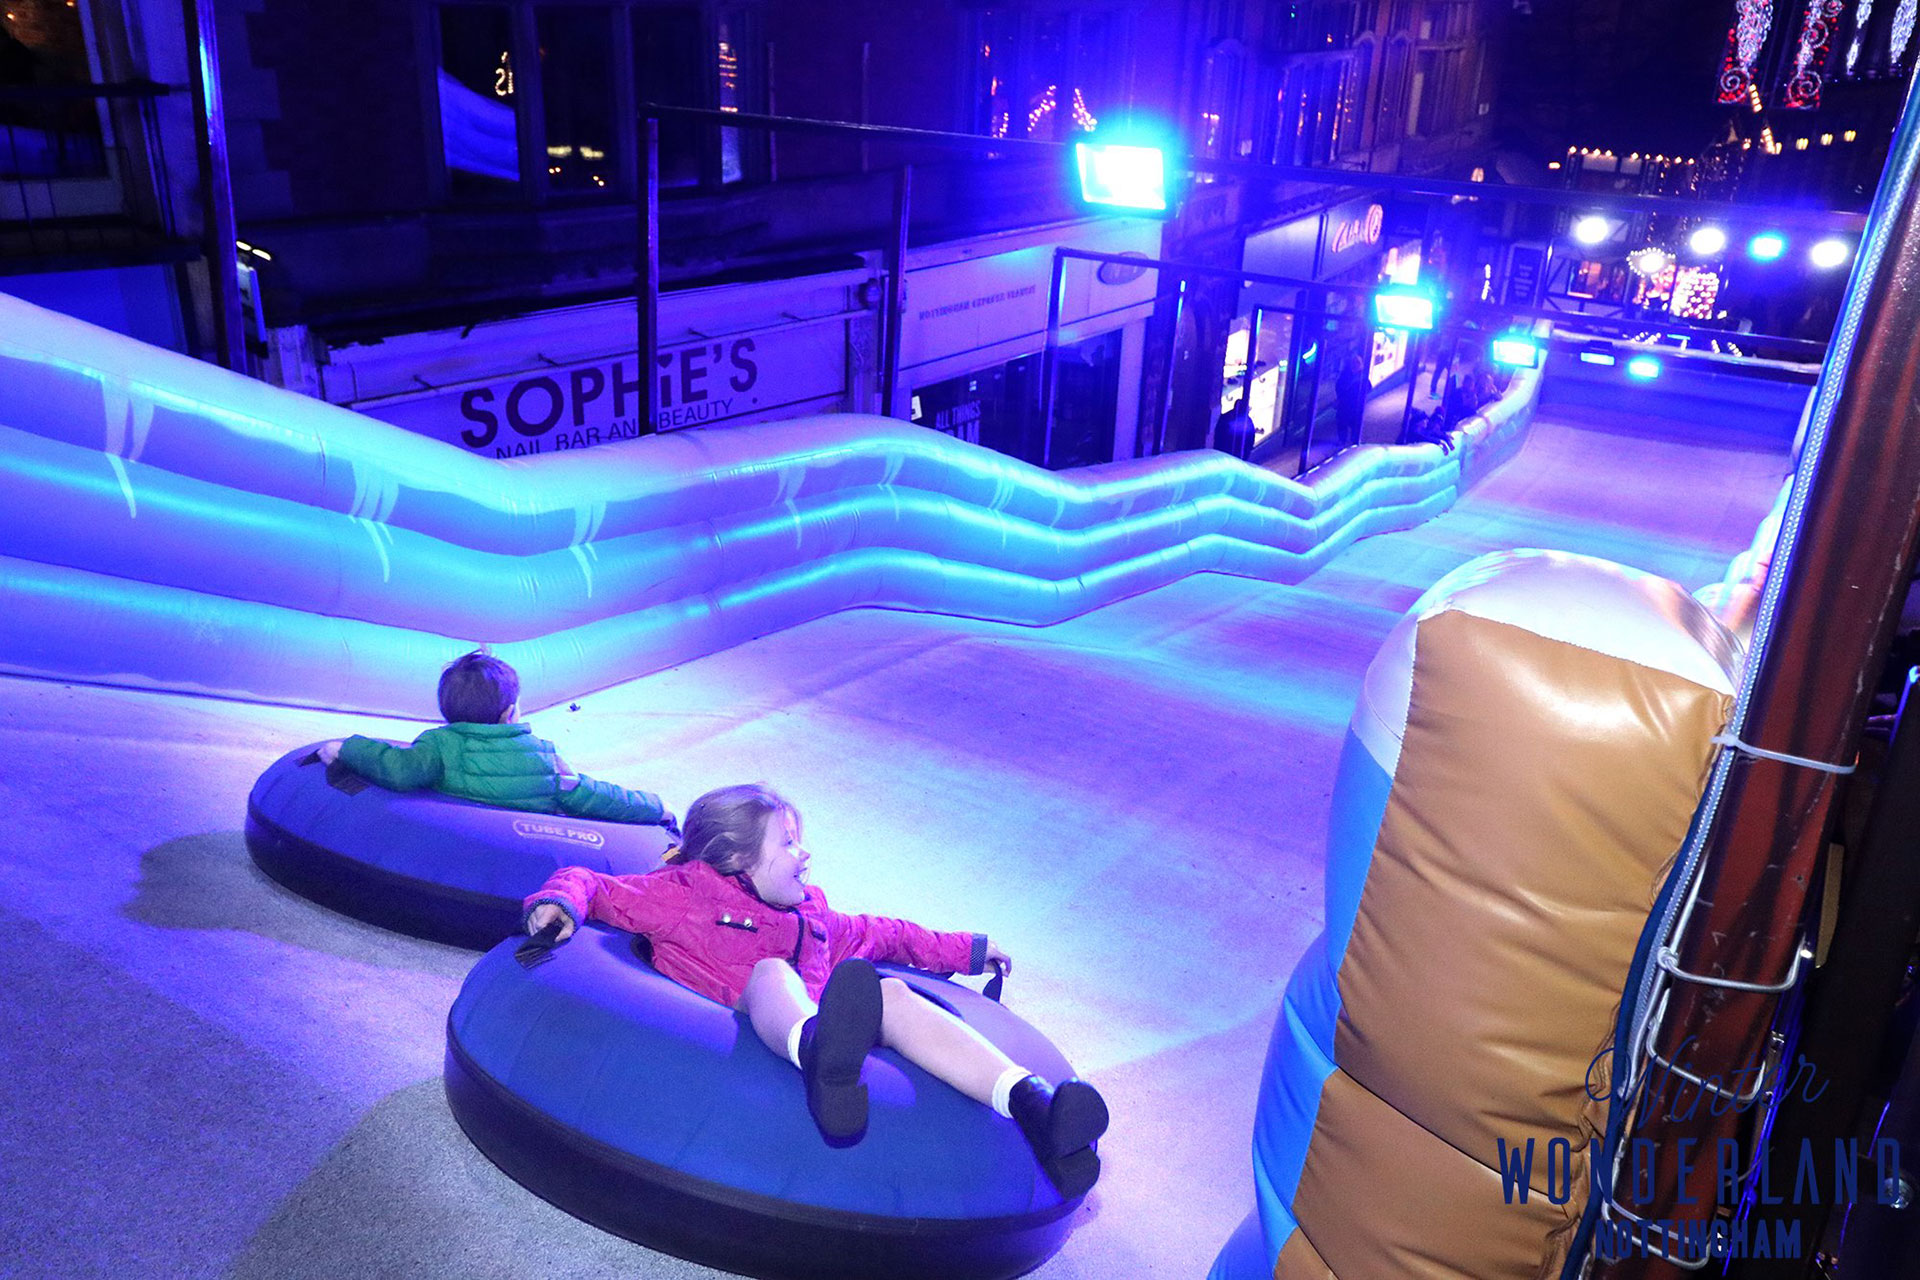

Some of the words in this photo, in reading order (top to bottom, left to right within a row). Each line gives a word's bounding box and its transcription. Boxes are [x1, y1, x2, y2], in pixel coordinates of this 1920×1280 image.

[555, 426, 601, 451] BAR
[607, 418, 637, 441] AN
[658, 398, 734, 430] BEAUTY
[520, 823, 565, 836] TUBE
[567, 829, 598, 843] PRO
